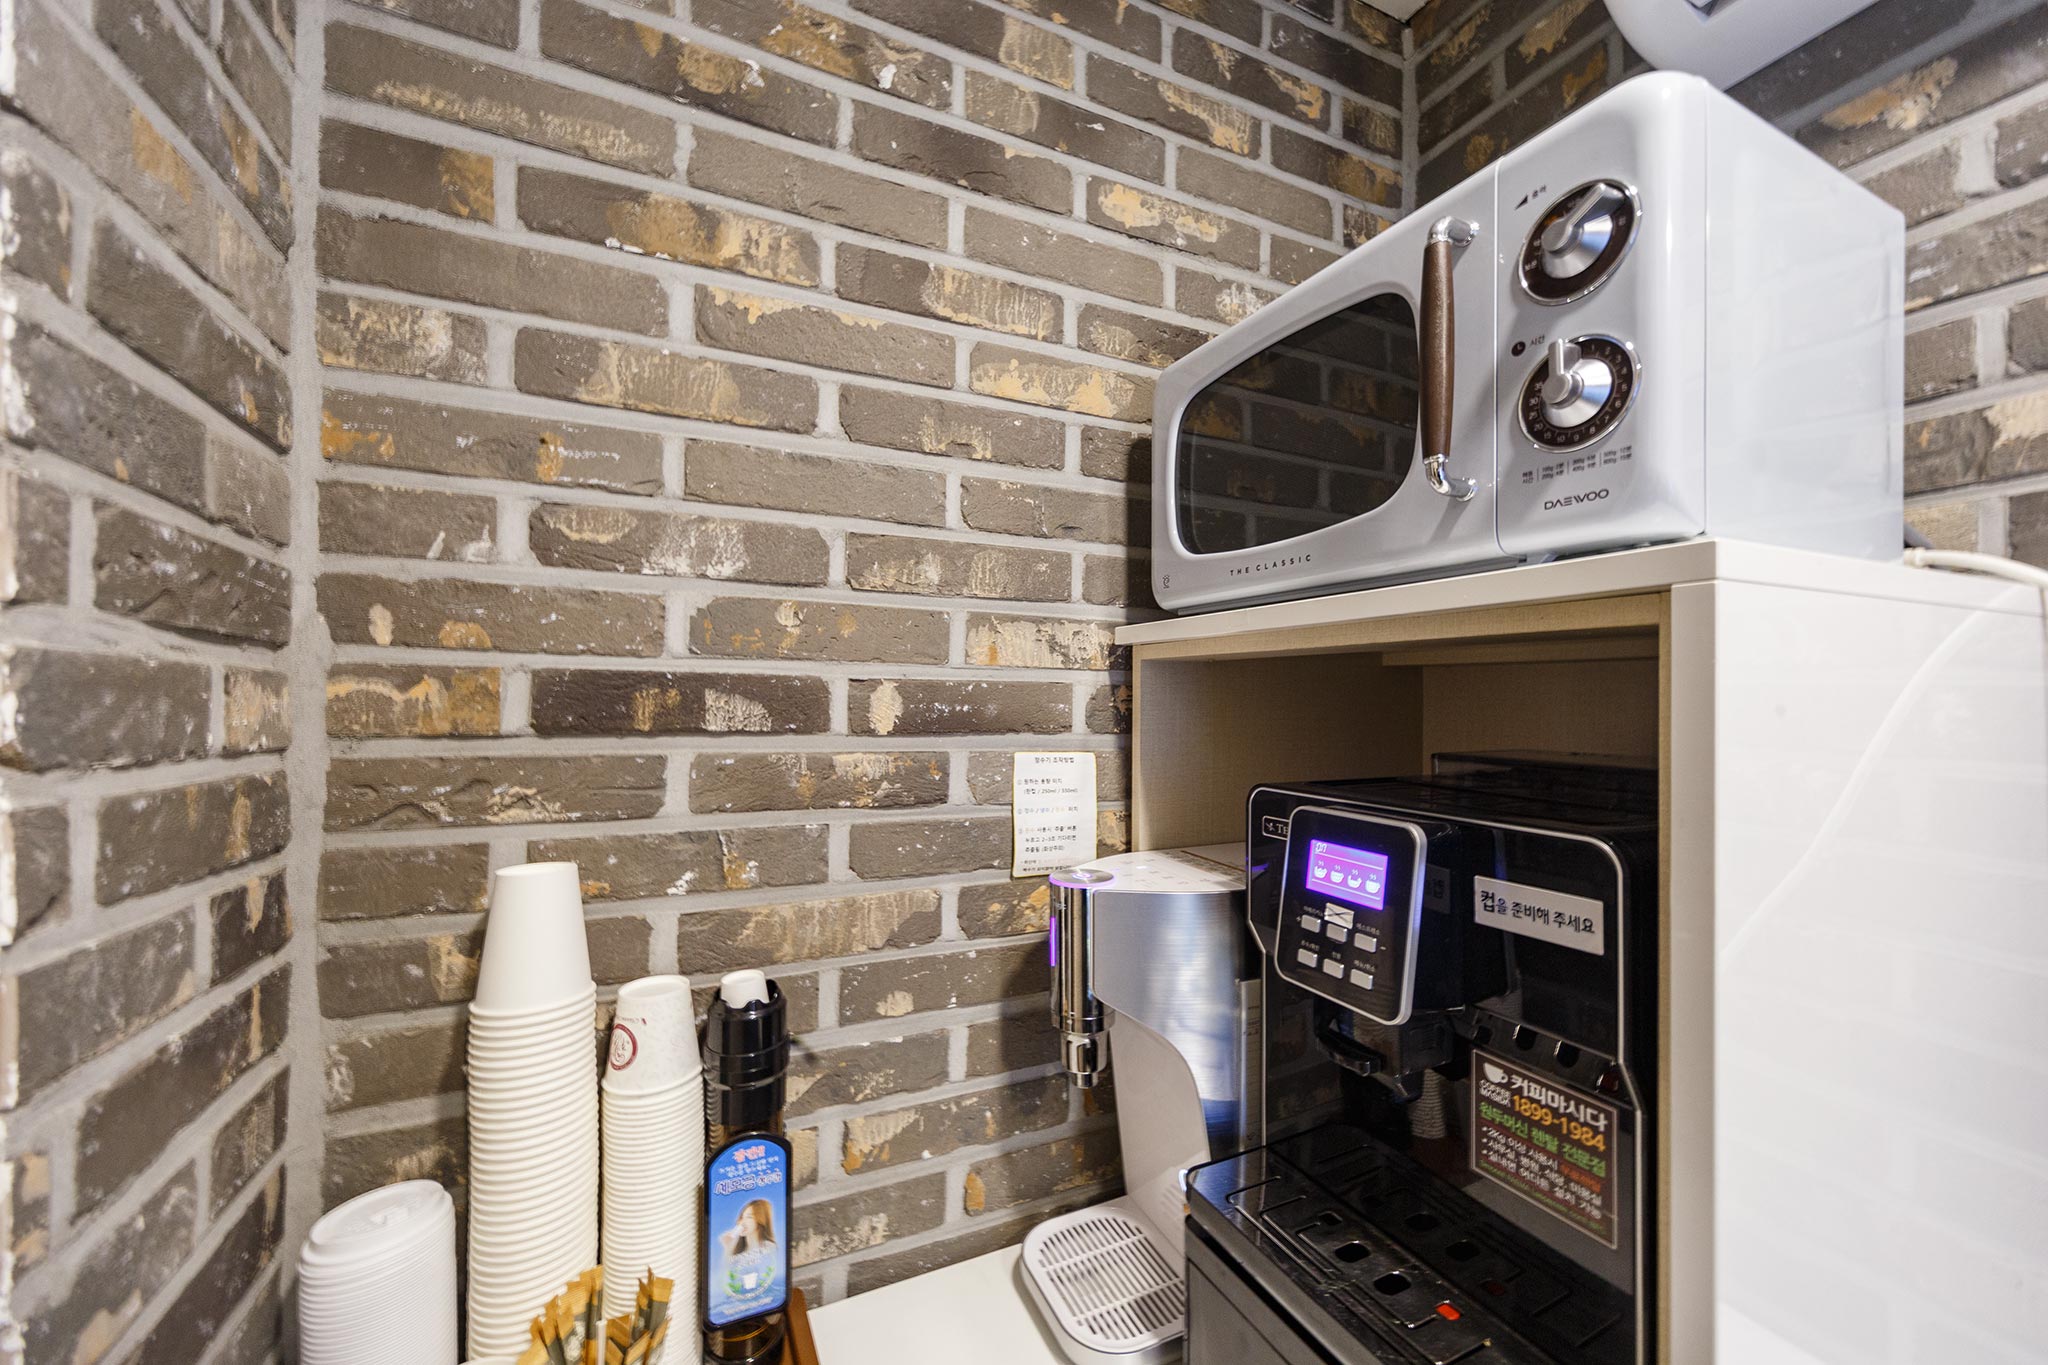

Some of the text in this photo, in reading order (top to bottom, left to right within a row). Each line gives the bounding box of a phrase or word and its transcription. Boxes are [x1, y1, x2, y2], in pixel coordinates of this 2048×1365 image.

[1544, 488, 1610, 511] DAEWOO
[1230, 554, 1312, 577] THE CLASSIC
[1480, 890, 1595, 934] 컵을 준비해 주세요
[1510, 1074, 1608, 1132] 커피마시다
[1512, 1095, 1606, 1152] 1899-1984
